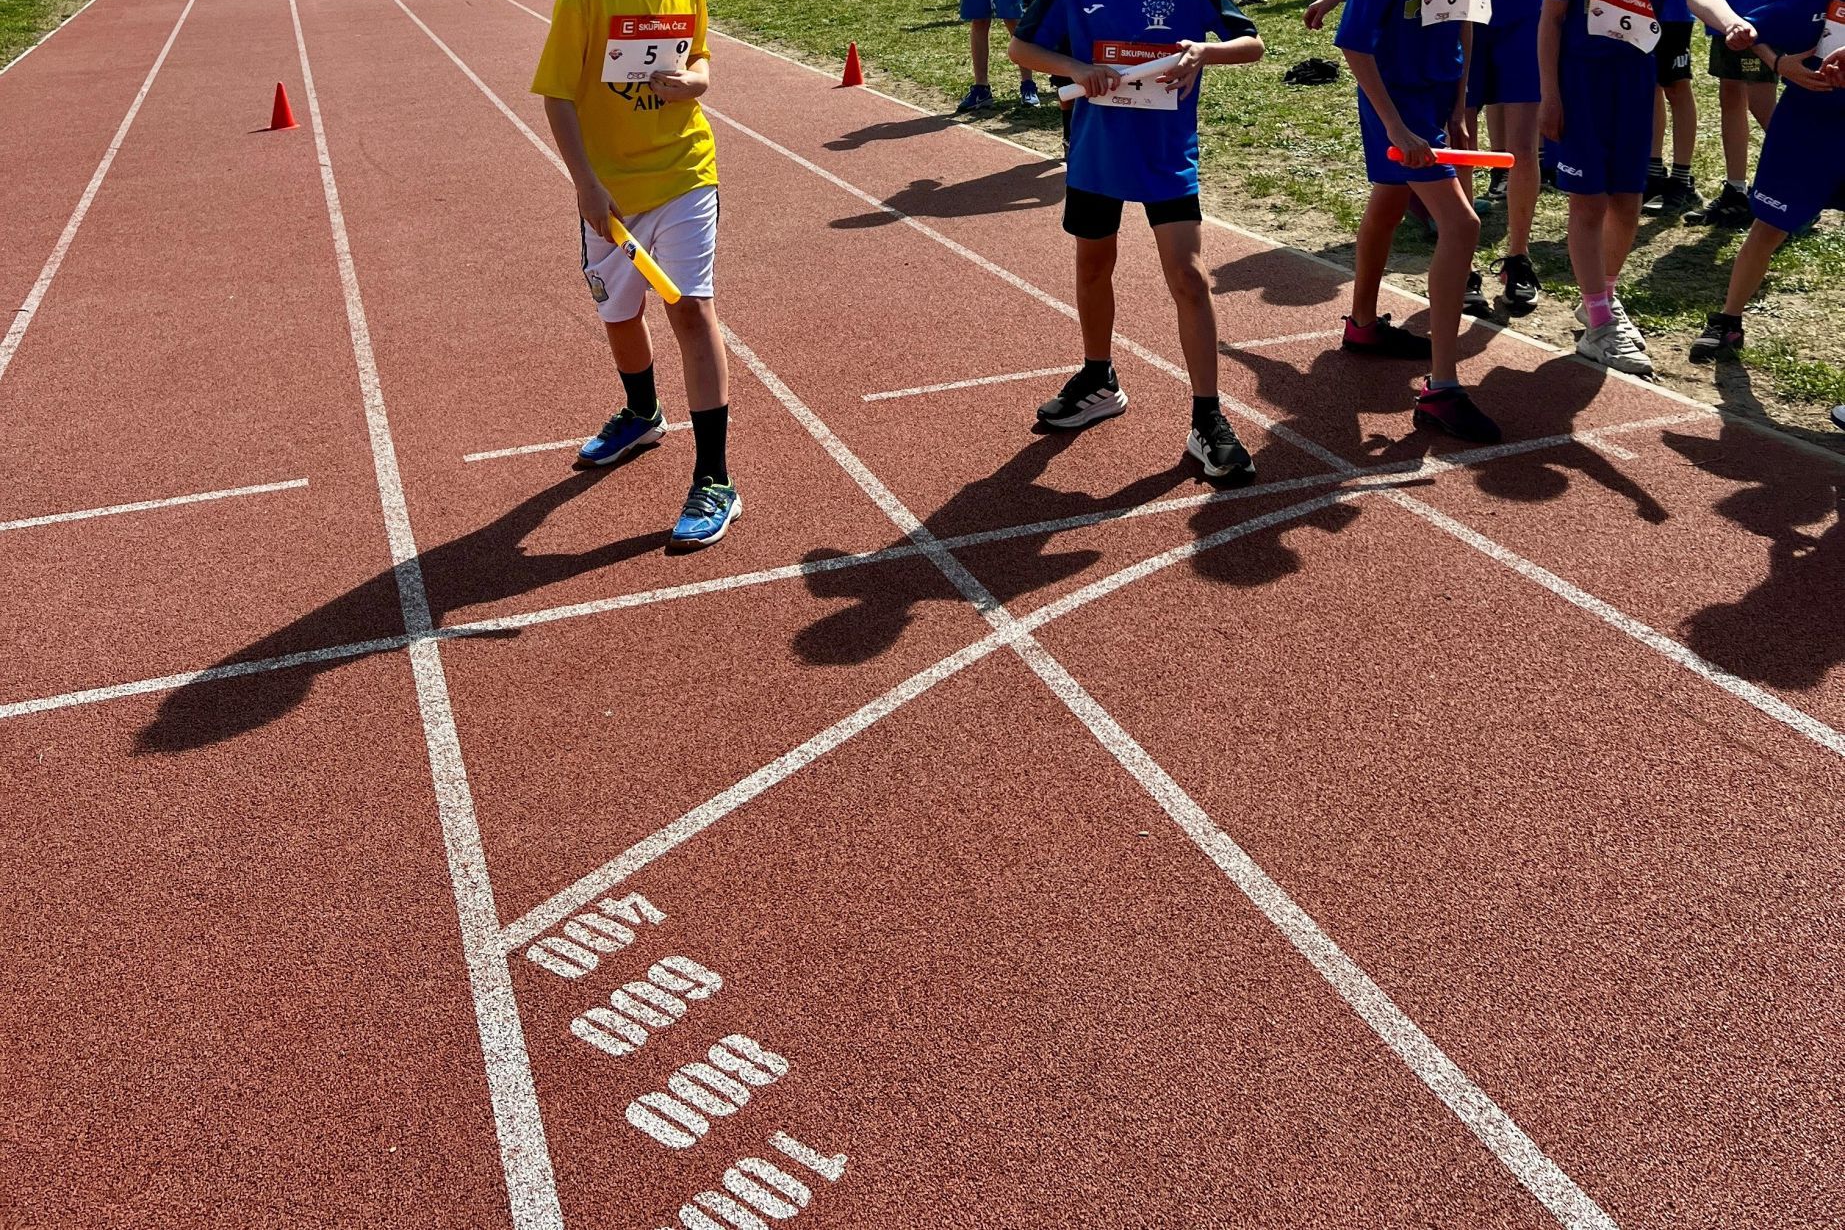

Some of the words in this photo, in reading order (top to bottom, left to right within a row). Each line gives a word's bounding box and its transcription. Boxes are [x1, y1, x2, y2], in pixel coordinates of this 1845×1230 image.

[638, 22, 671, 31] SKUPINA
[671, 21, 687, 30] ČEZ
[1620, 15, 1632, 31] 6
[643, 45, 658, 65] 5
[1120, 49, 1156, 59] SKUPINA
[1556, 161, 1583, 178] EGEA
[1753, 189, 1788, 213] LEGEA
[525, 891, 668, 979] 400
[569, 954, 724, 1057] 600
[624, 1033, 790, 1150] 800
[654, 1130, 848, 1230] 100
